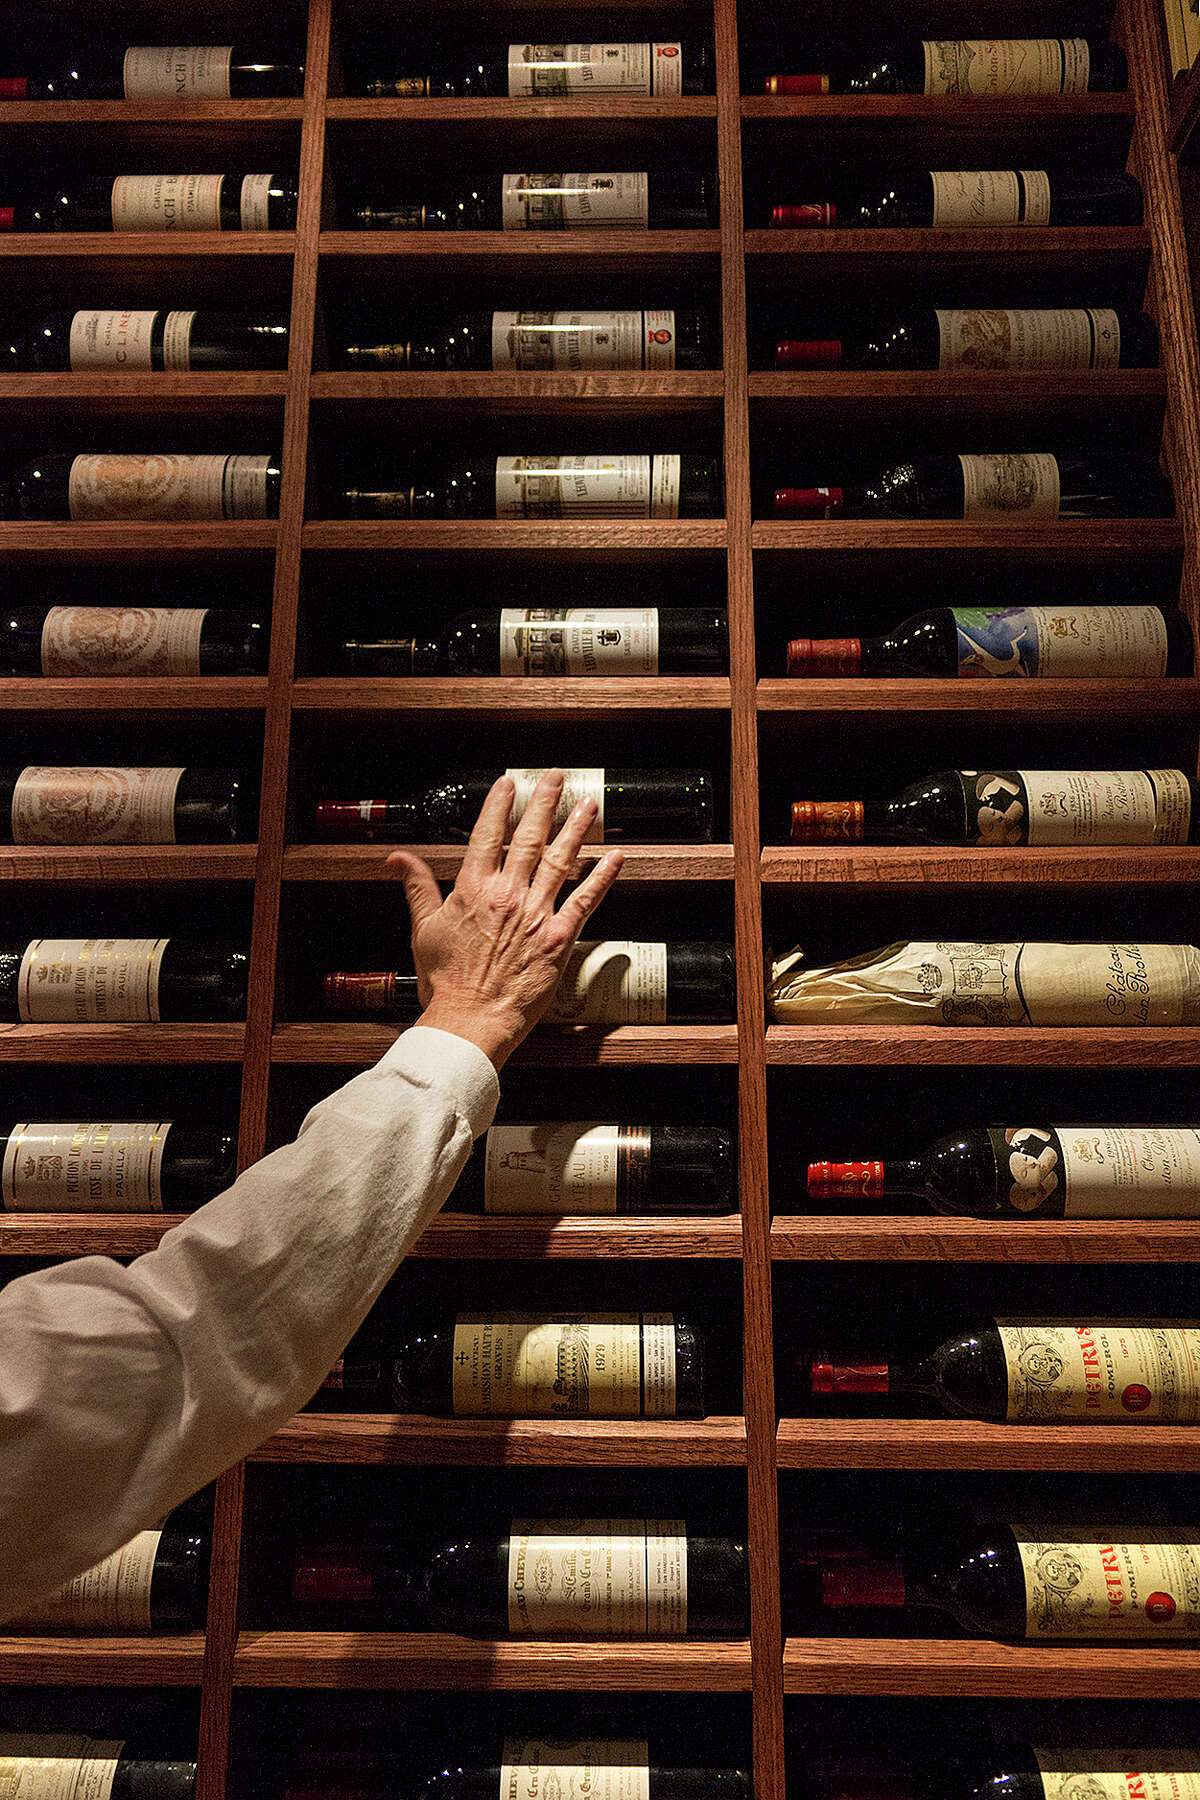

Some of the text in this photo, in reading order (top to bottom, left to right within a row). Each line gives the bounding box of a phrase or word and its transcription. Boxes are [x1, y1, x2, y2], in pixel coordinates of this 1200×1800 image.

[75, 967, 87, 995] PICHON
[96, 966, 107, 975] DE
[118, 960, 127, 999] PAUILL
[95, 980, 107, 1017] COMTESSE
[66, 1161, 79, 1193] PICHON
[89, 1159, 102, 1170] DE
[115, 1147, 126, 1198] PAUILLA
[494, 1337, 504, 1380] GRAVES
[595, 1343, 606, 1373] 1979
[1119, 1338, 1129, 1360] 1975
[1100, 1333, 1116, 1400] POMEROL
[539, 1566, 548, 1584] 1982
